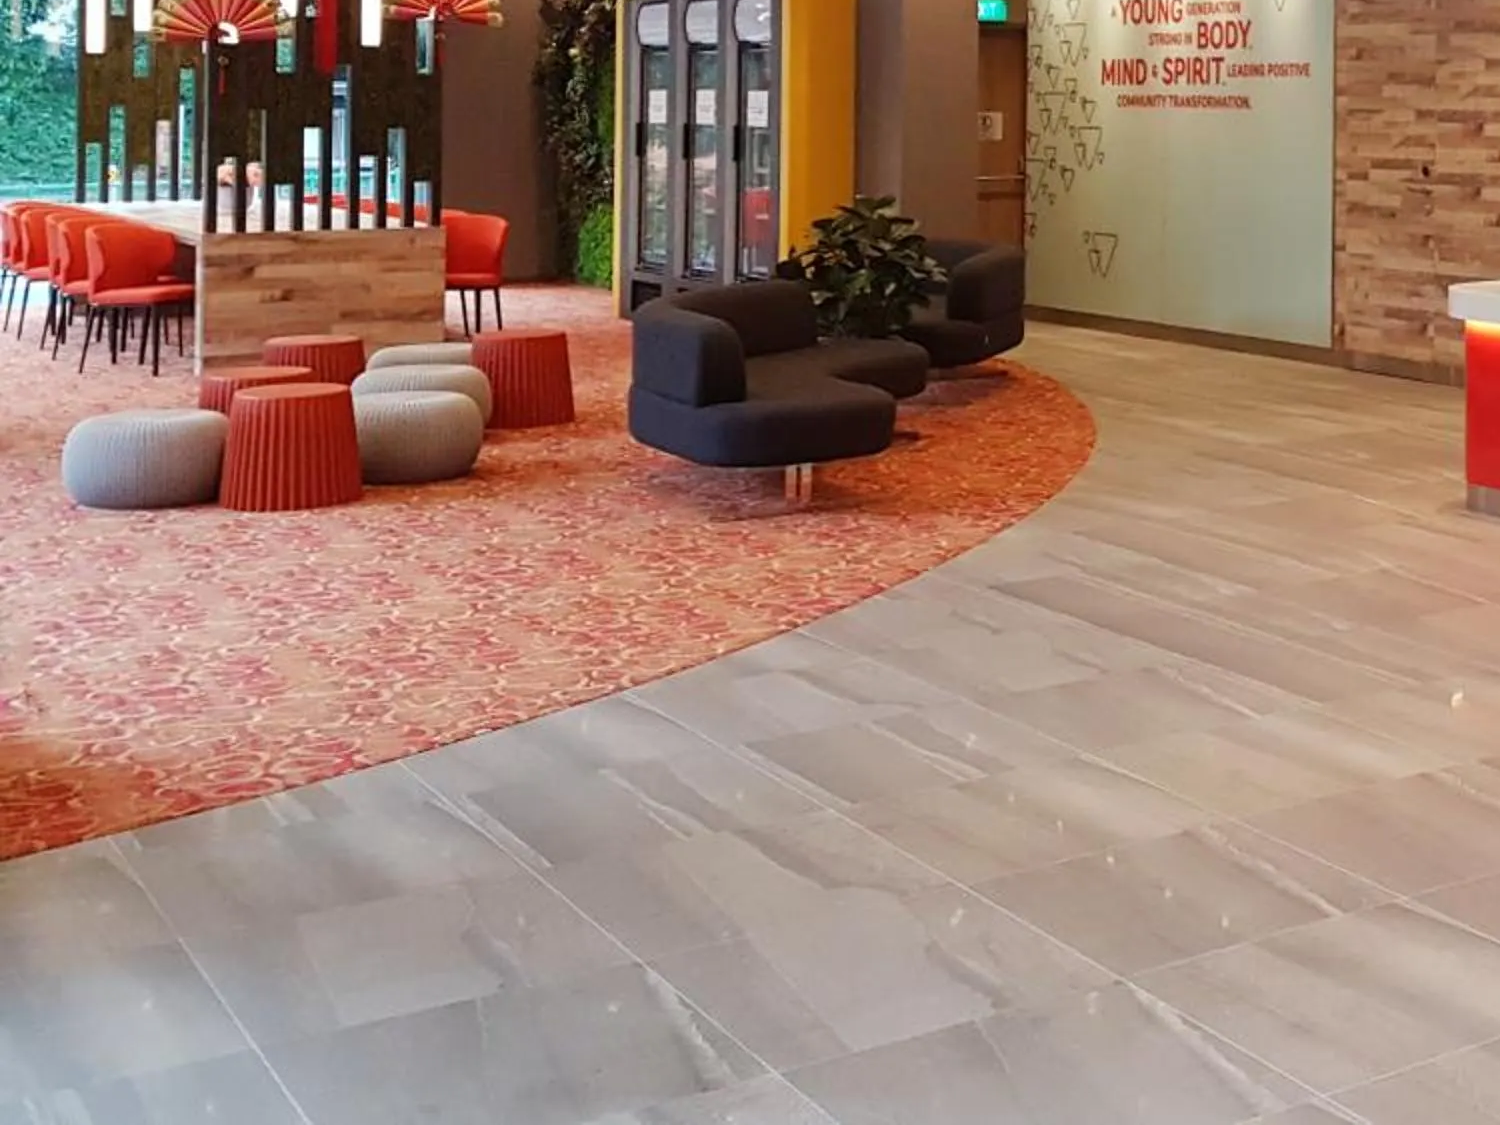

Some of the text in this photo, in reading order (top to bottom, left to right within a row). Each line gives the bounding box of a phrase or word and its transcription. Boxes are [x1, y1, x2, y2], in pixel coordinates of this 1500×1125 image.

[1186, 0, 1242, 16] GENERATION
[1148, 32, 1182, 47] STRONG
[1101, 57, 1149, 87] MIND
[1151, 64, 1158, 78] &
[1227, 63, 1265, 78] LEADING
[1266, 62, 1311, 78] POSITIVE
[1116, 93, 1168, 109] COMMUNITY
